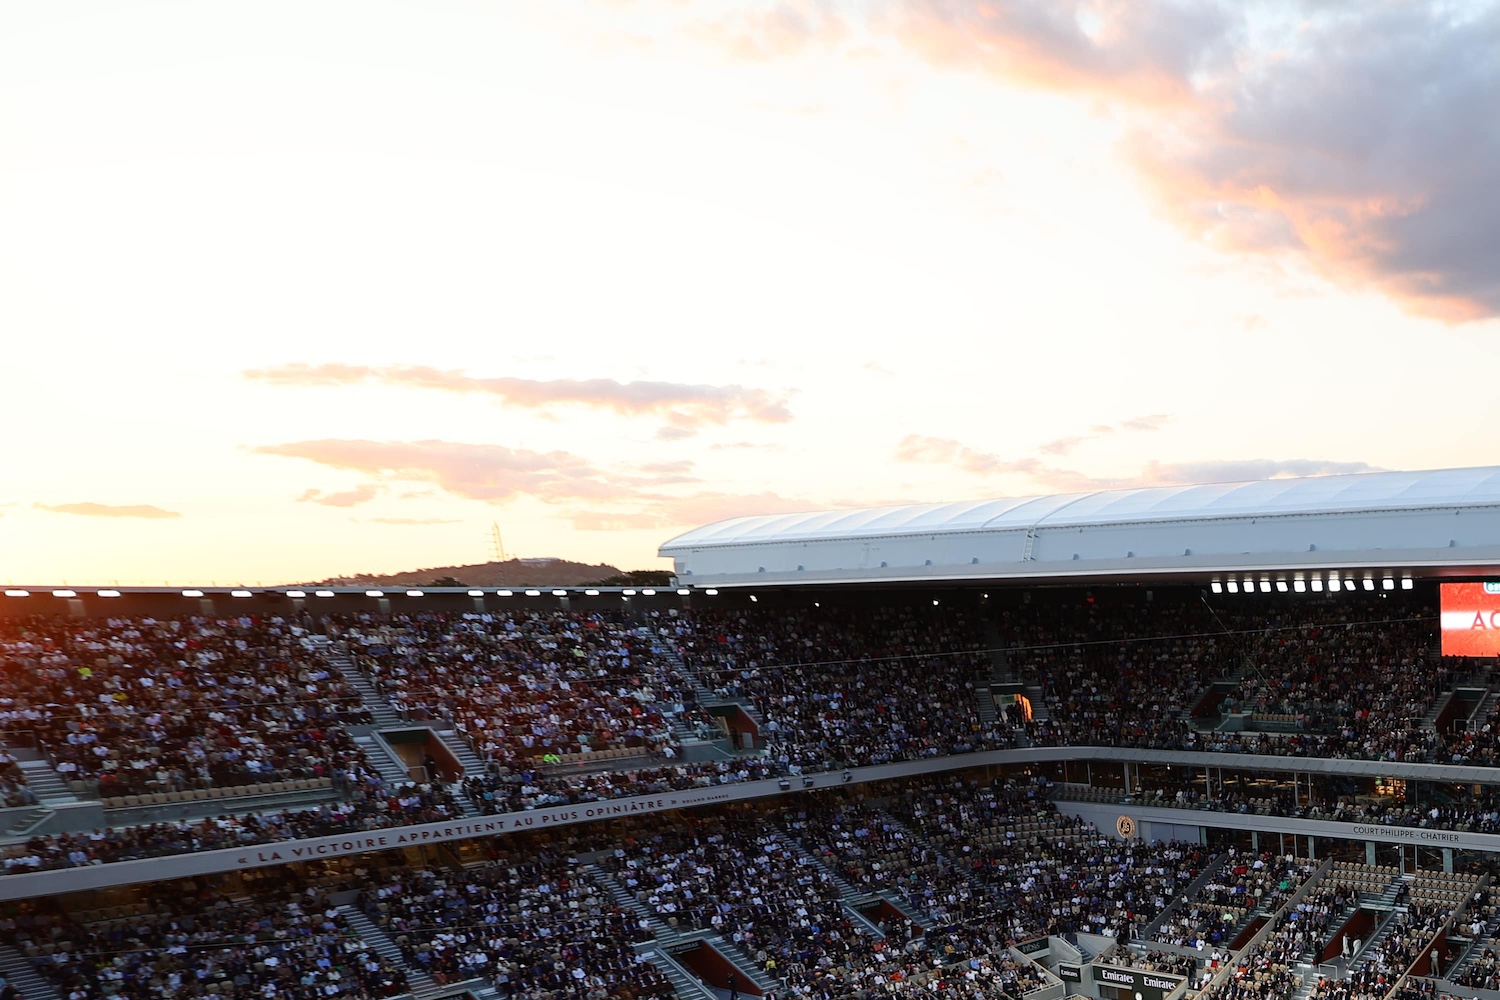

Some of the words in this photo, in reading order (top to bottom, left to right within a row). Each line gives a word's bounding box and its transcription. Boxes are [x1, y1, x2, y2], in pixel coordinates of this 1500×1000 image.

[258, 852, 282, 862] LA
[292, 837, 387, 857] VICTOIRE
[397, 821, 505, 843] APPARTIENT
[514, 817, 533, 828] AU
[542, 811, 578, 824] PLUS
[586, 800, 664, 817] OPINIÂTRE
[1353, 826, 1379, 835] COURT
[1380, 829, 1414, 838] PHILIPPE
[1420, 832, 1459, 842] CHATRIER
[1102, 969, 1135, 984] Emirates
[1143, 976, 1177, 990] Emirates
